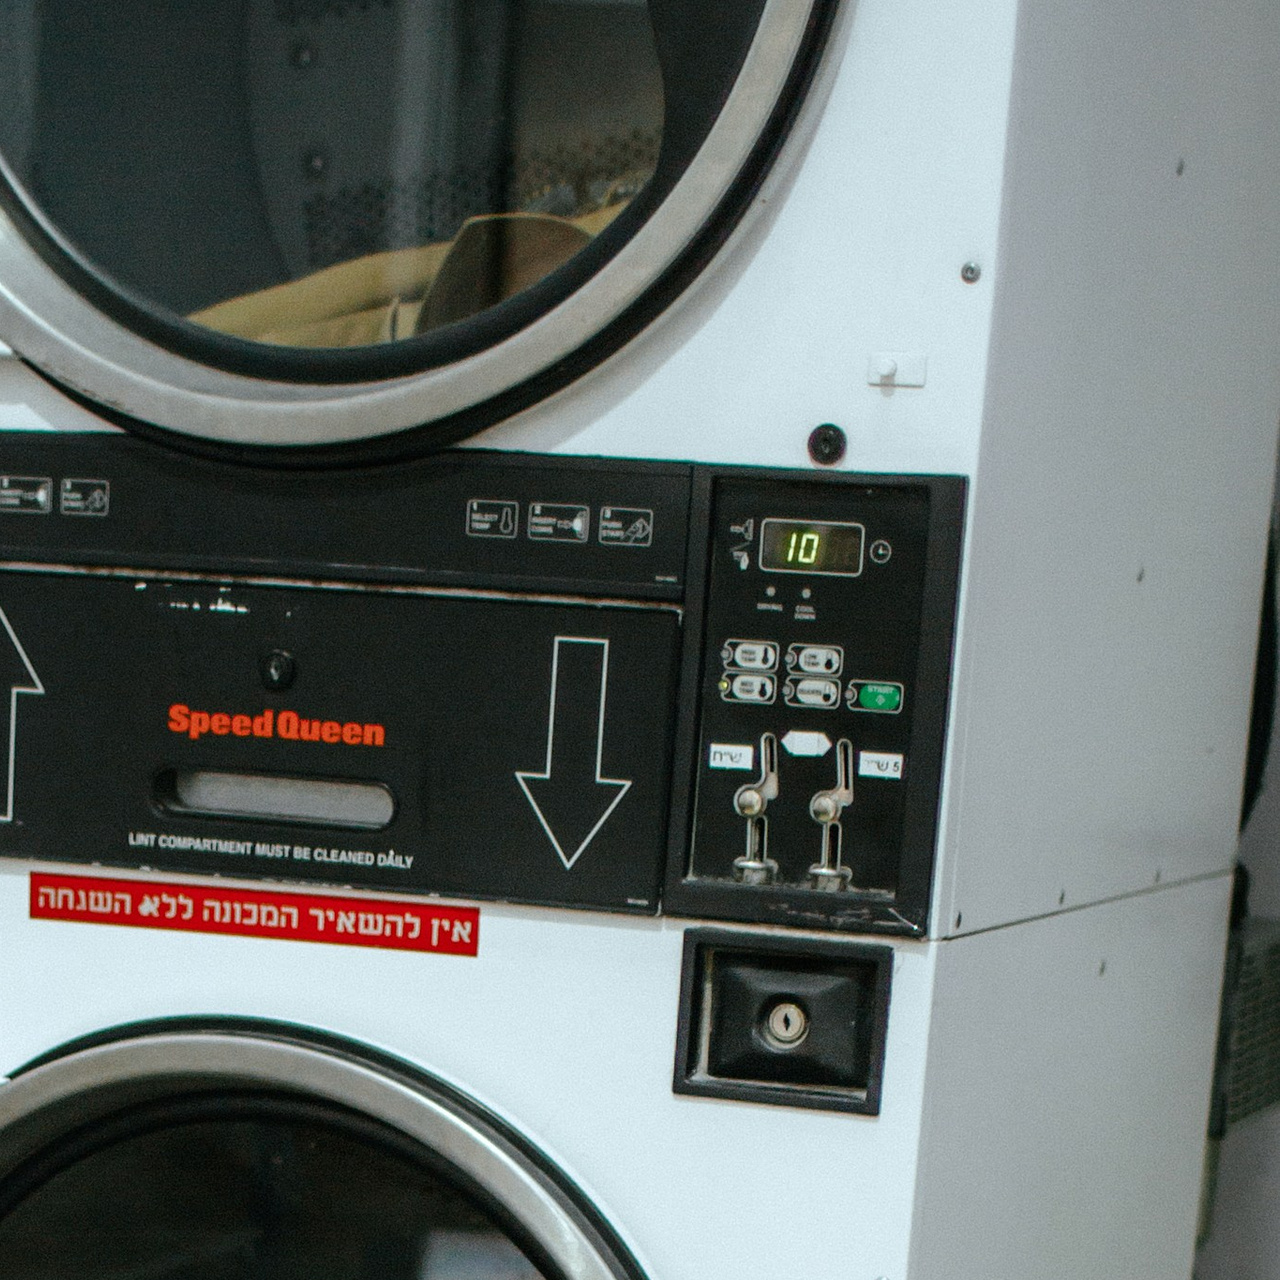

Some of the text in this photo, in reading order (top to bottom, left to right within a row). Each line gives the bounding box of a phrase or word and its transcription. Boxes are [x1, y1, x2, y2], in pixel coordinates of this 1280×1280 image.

[787, 532, 820, 564] 10
[168, 703, 386, 747] Speed Queen
[128, 832, 414, 869] LINT COMPARTMENT MUST BE CLEANED DAILY
[137, 892, 194, 921] ללא
[202, 898, 299, 930] המכונה
[308, 907, 421, 940] להשאיר
[430, 917, 473, 947] אין
